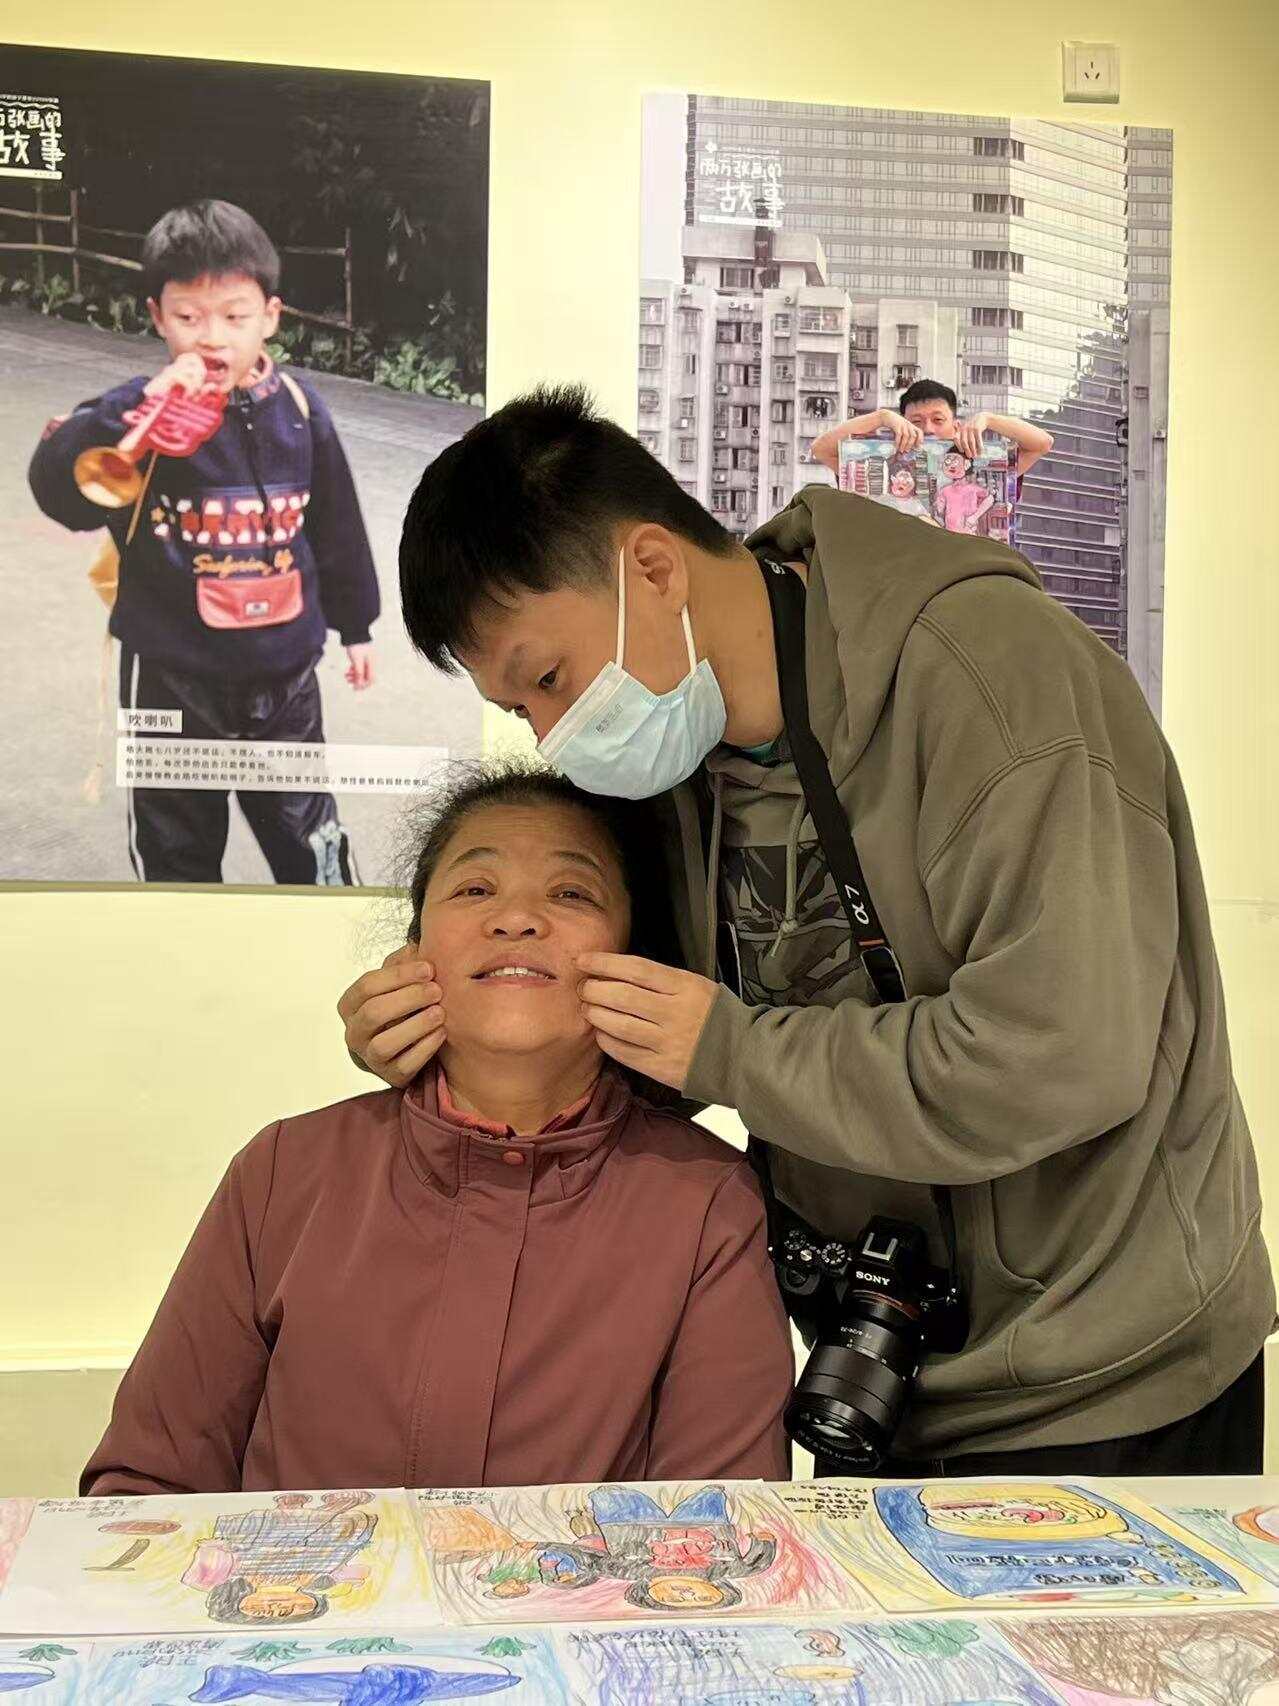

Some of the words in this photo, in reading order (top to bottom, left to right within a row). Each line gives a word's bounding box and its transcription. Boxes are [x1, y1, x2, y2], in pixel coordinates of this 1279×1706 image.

[716, 180, 786, 219] 故事
[128, 713, 173, 728] 吹喇叭
[855, 1270, 891, 1286] SONY
